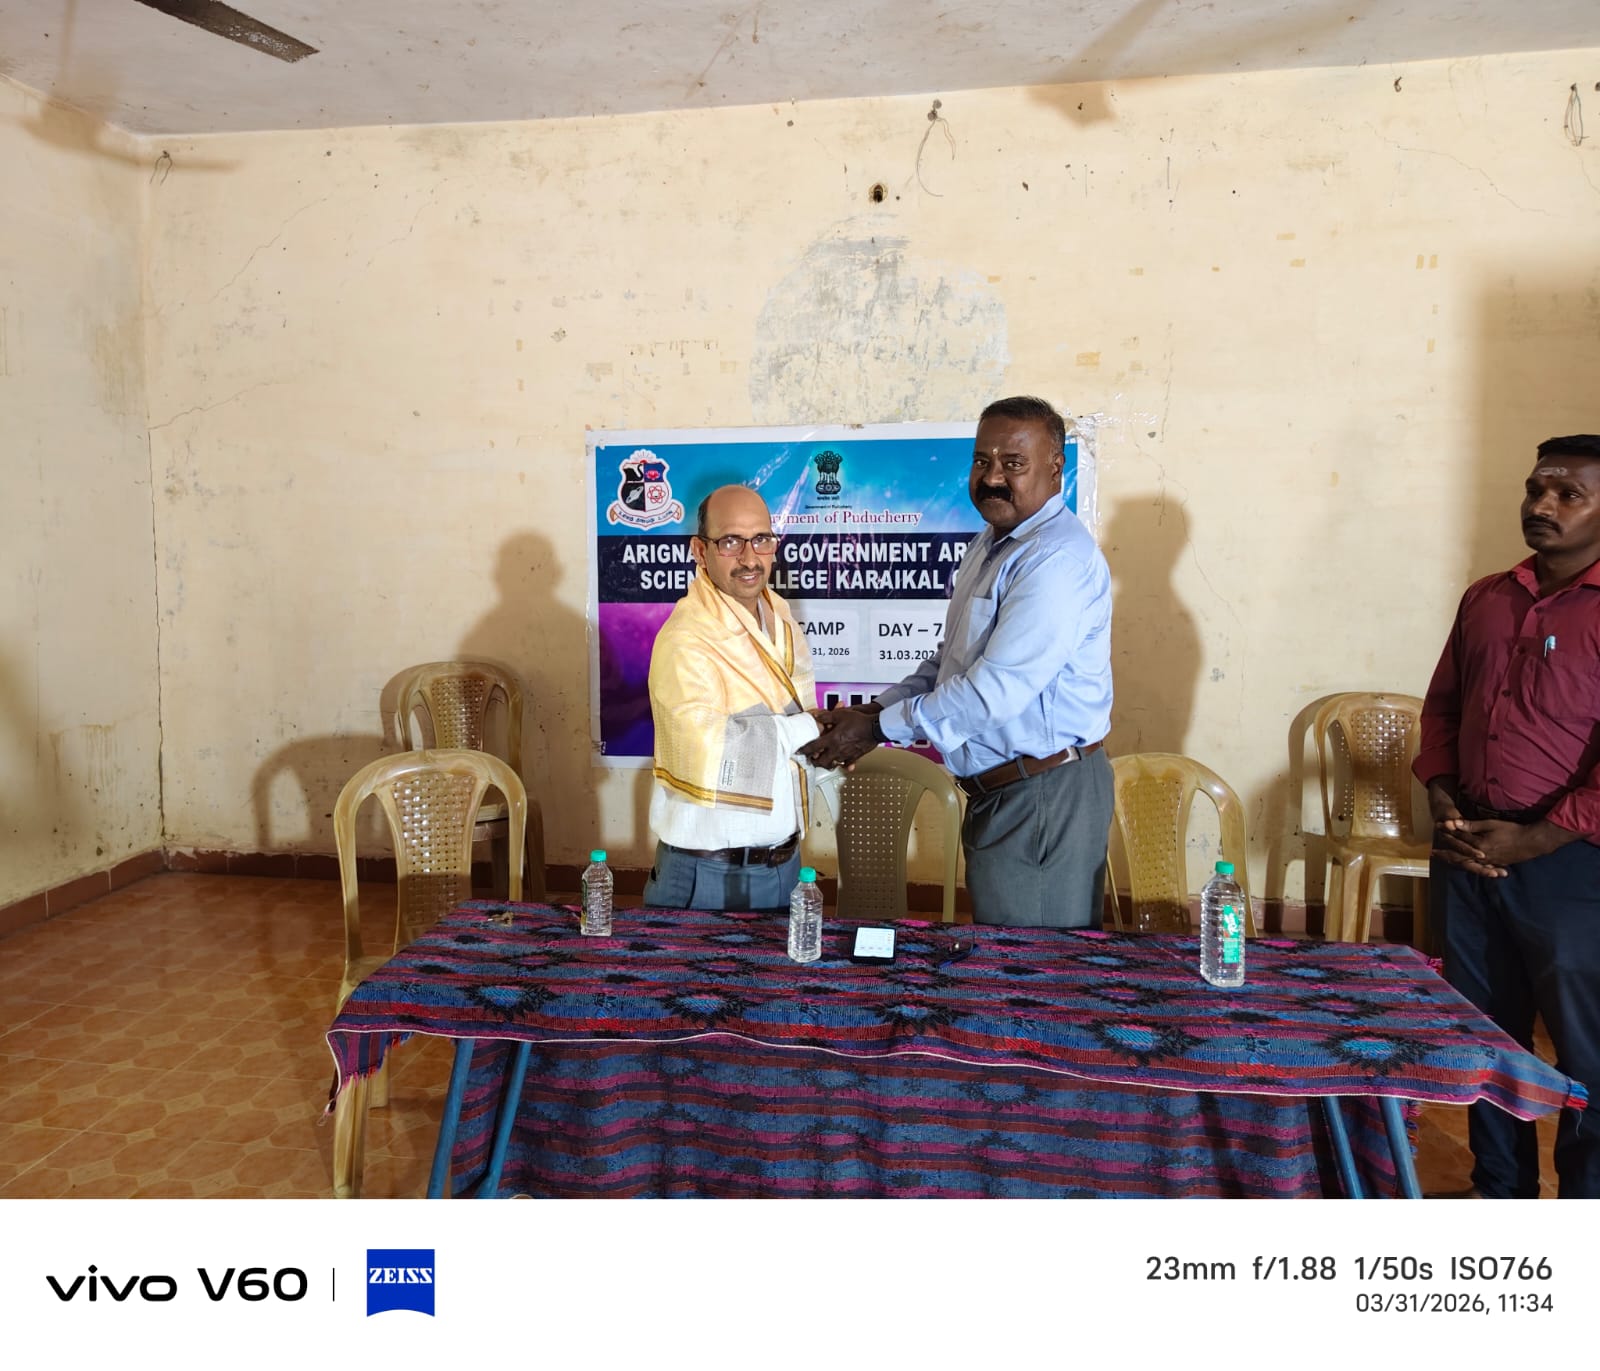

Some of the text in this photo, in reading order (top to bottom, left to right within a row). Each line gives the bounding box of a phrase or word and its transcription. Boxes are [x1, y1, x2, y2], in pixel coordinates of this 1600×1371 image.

[771, 511, 922, 526] rment of Puducherry
[622, 543, 698, 564] ARIGNA
[783, 541, 932, 563] GOVERNMENT
[937, 541, 971, 562] AR
[640, 569, 697, 590] SCIE
[767, 569, 829, 590] LEGE
[835, 569, 945, 591] KARAIKAL
[878, 623, 913, 637] DAY
[932, 622, 943, 637] 7
[811, 647, 850, 657] 31, 2026
[879, 650, 936, 661] 31.03.202
